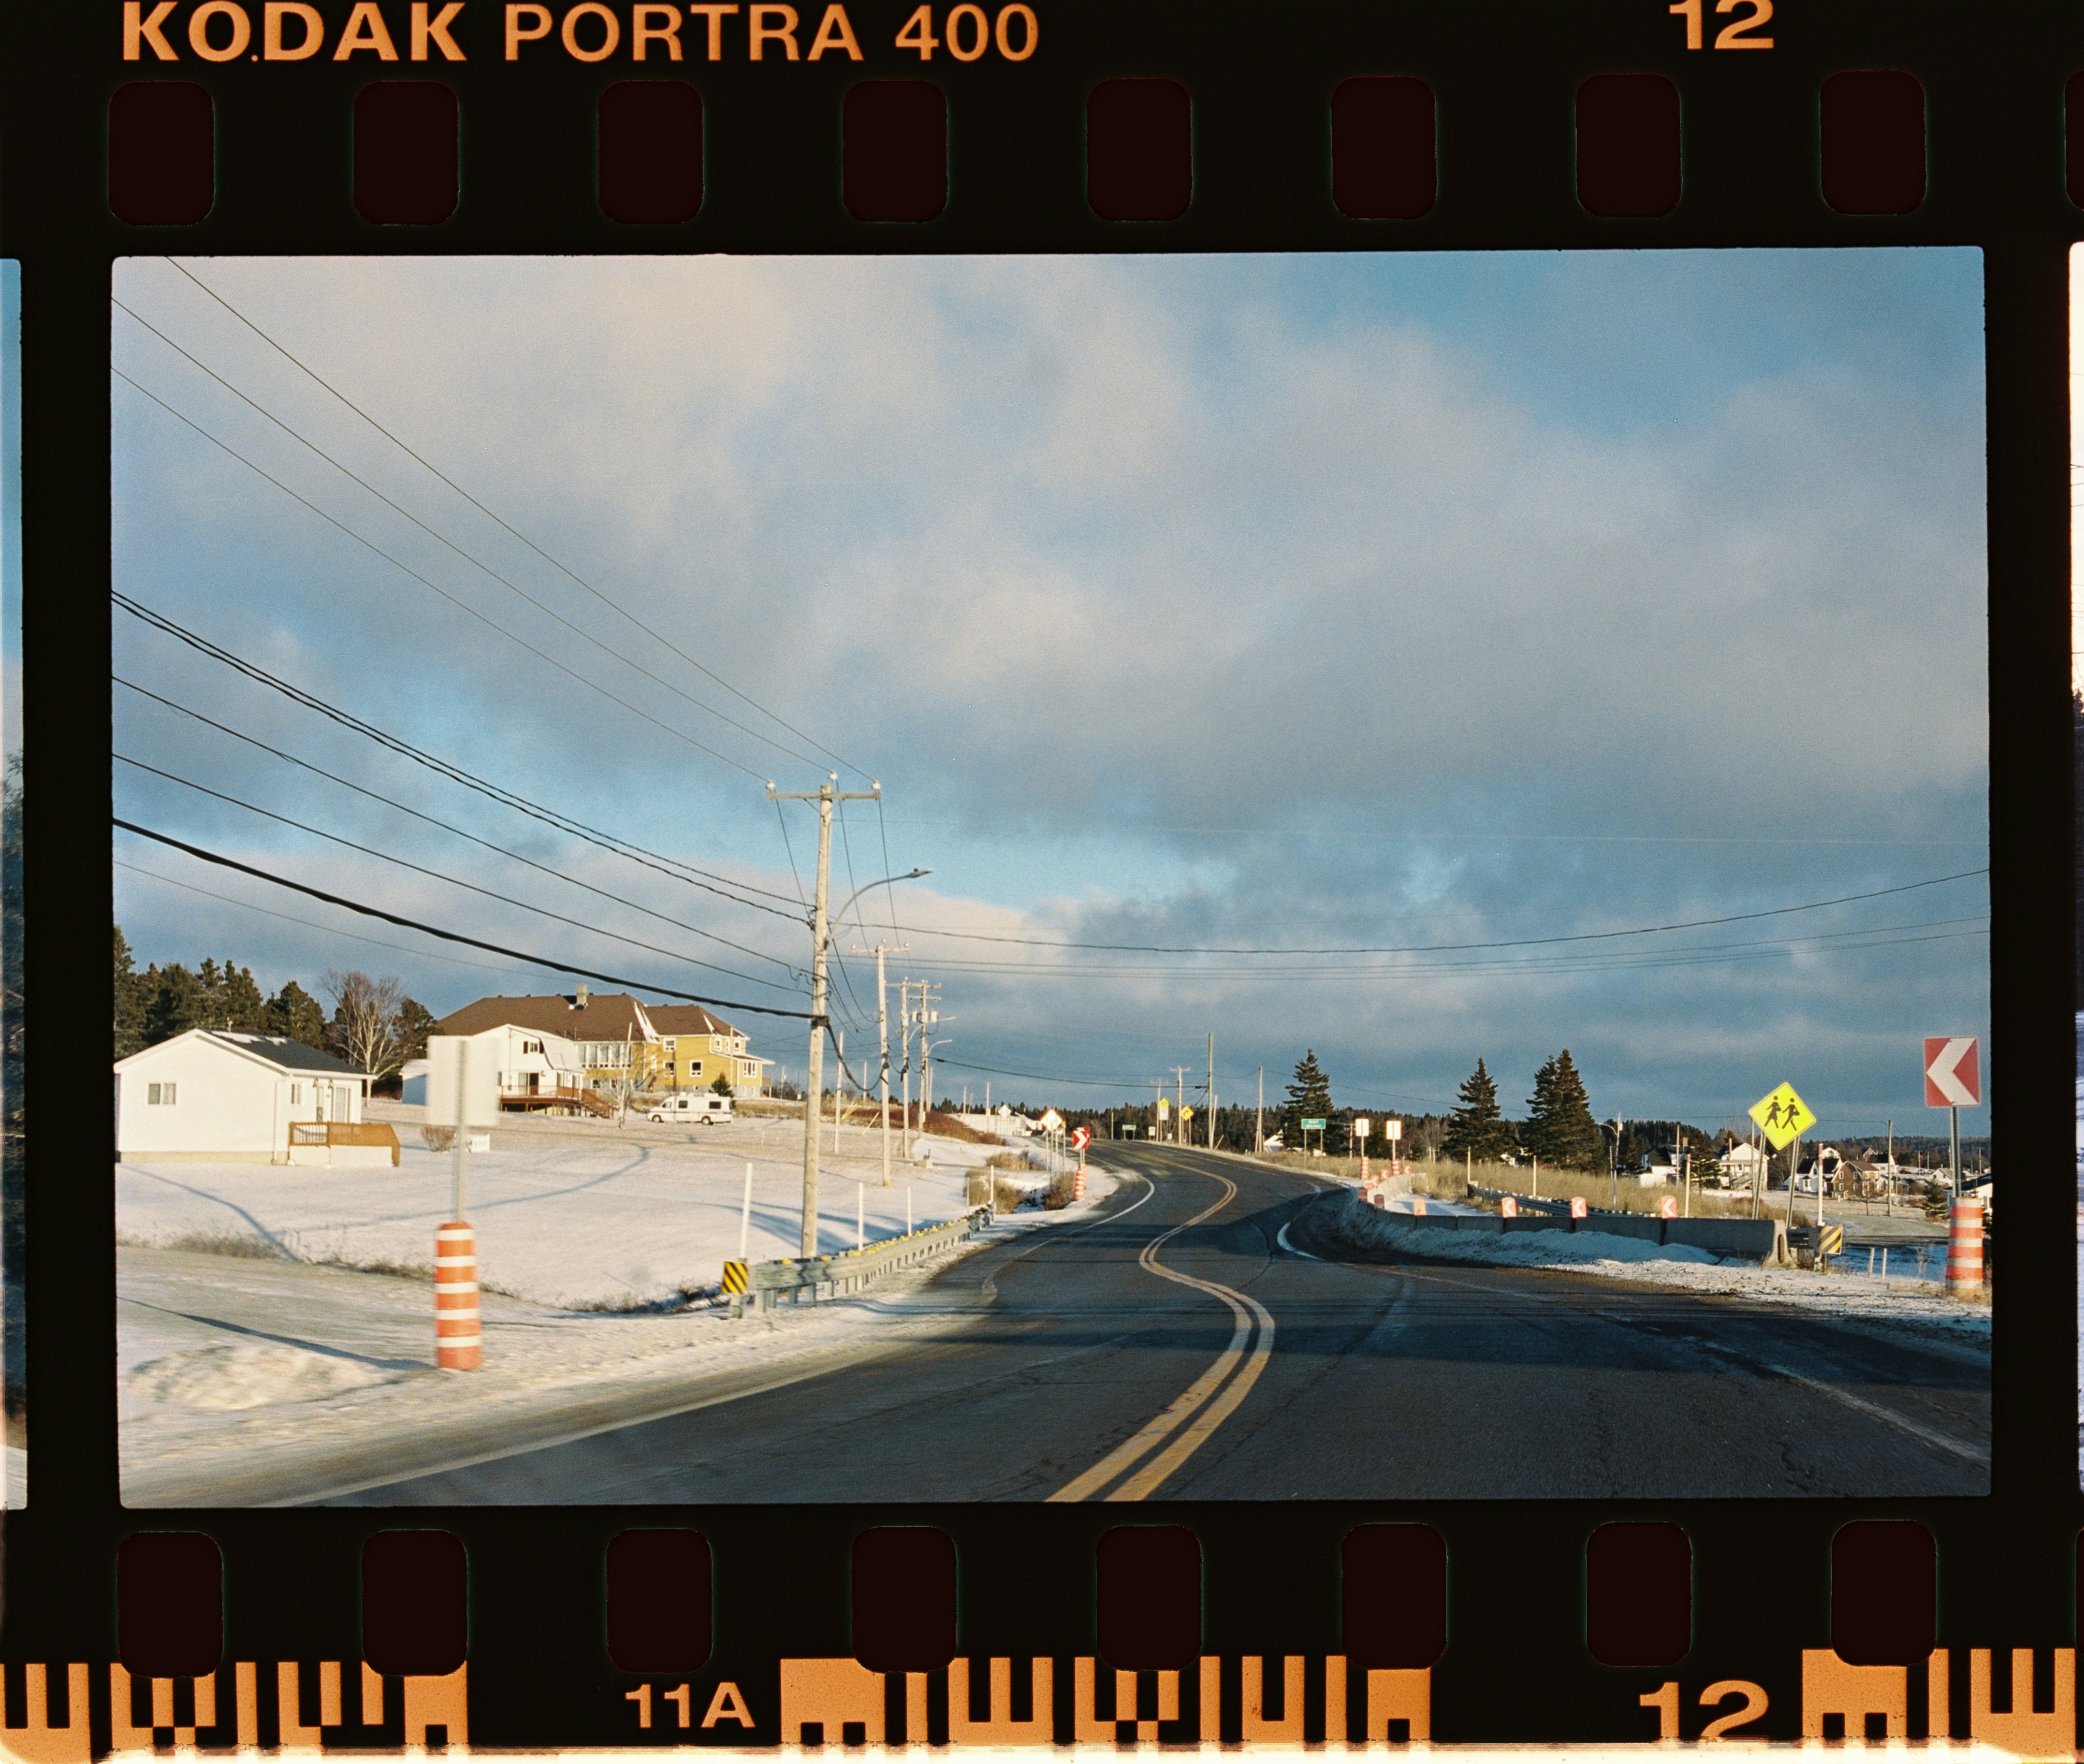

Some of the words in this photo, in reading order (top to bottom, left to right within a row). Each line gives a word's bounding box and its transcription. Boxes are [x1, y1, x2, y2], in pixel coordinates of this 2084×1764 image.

[505, 2, 864, 61] PORTRA
[895, 3, 1039, 61] 400
[1669, 0, 1774, 49] 12
[625, 1682, 756, 1728] 11A
[1639, 1679, 1769, 1746] 12
